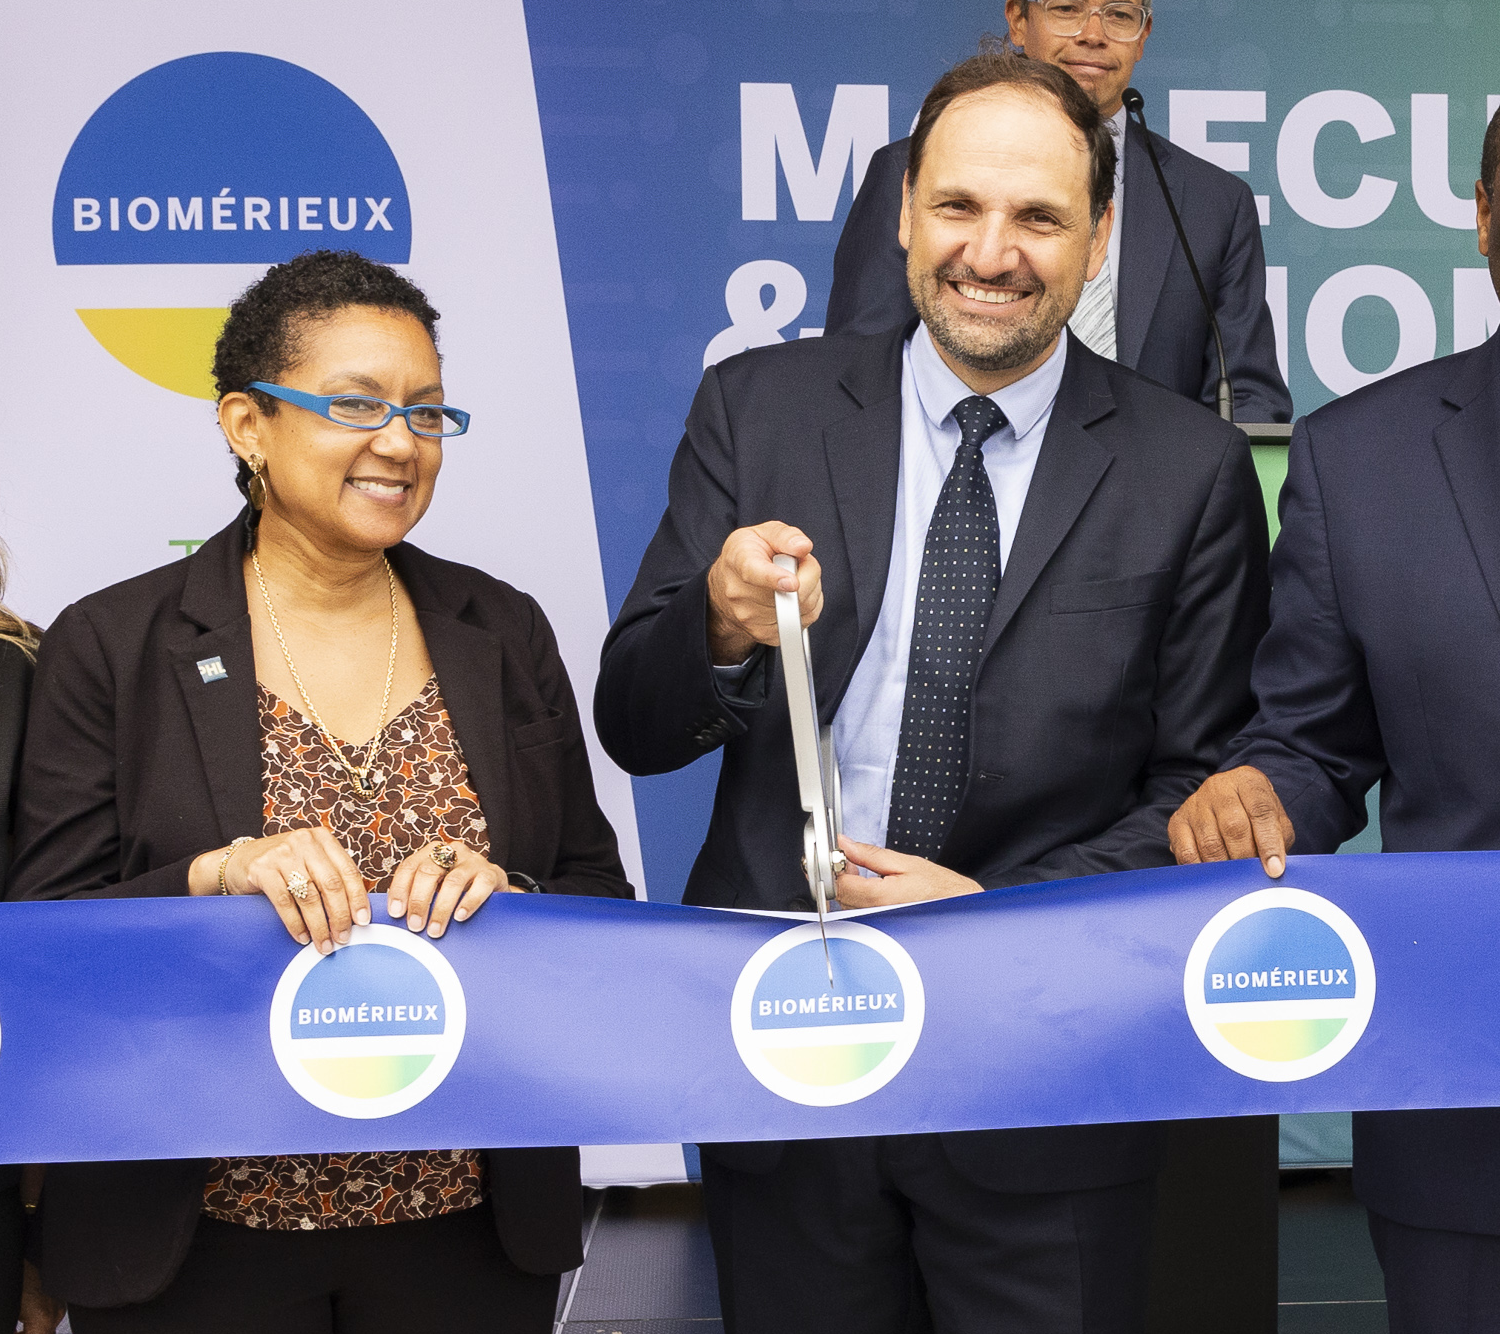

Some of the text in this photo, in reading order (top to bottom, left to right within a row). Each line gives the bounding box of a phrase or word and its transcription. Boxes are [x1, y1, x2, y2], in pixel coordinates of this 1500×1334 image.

[72, 185, 394, 233] BIOMÉRIEUX
[1210, 968, 1349, 990] BIOMÉRIEUX
[297, 1005, 438, 1027] BIOMÉRIEUX
[758, 992, 898, 1018] BIOMÉRIEUX
